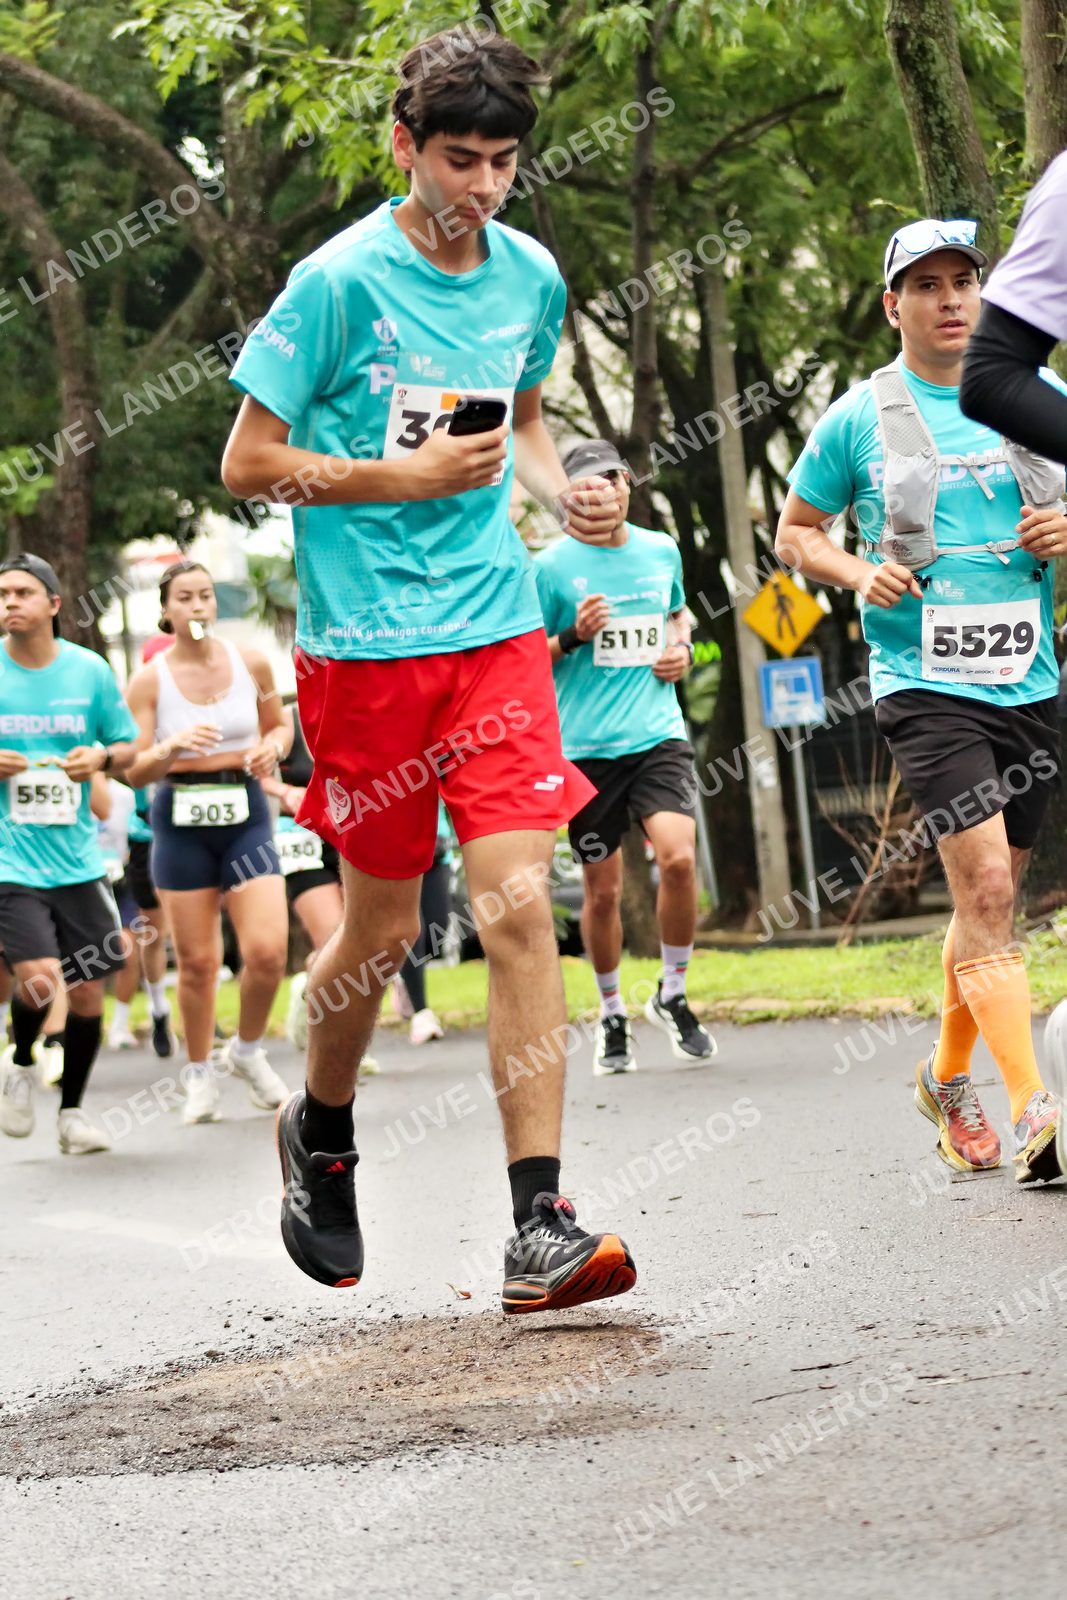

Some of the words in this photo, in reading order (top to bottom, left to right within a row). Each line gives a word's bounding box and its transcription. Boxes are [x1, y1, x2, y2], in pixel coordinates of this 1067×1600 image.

[376, 626, 417, 640] amigos
[600, 628, 657, 649] 5118
[931, 621, 1035, 658] 5529
[931, 666, 960, 674] PERDURA
[17, 785, 75, 806] 5591
[190, 803, 236, 824] 903
